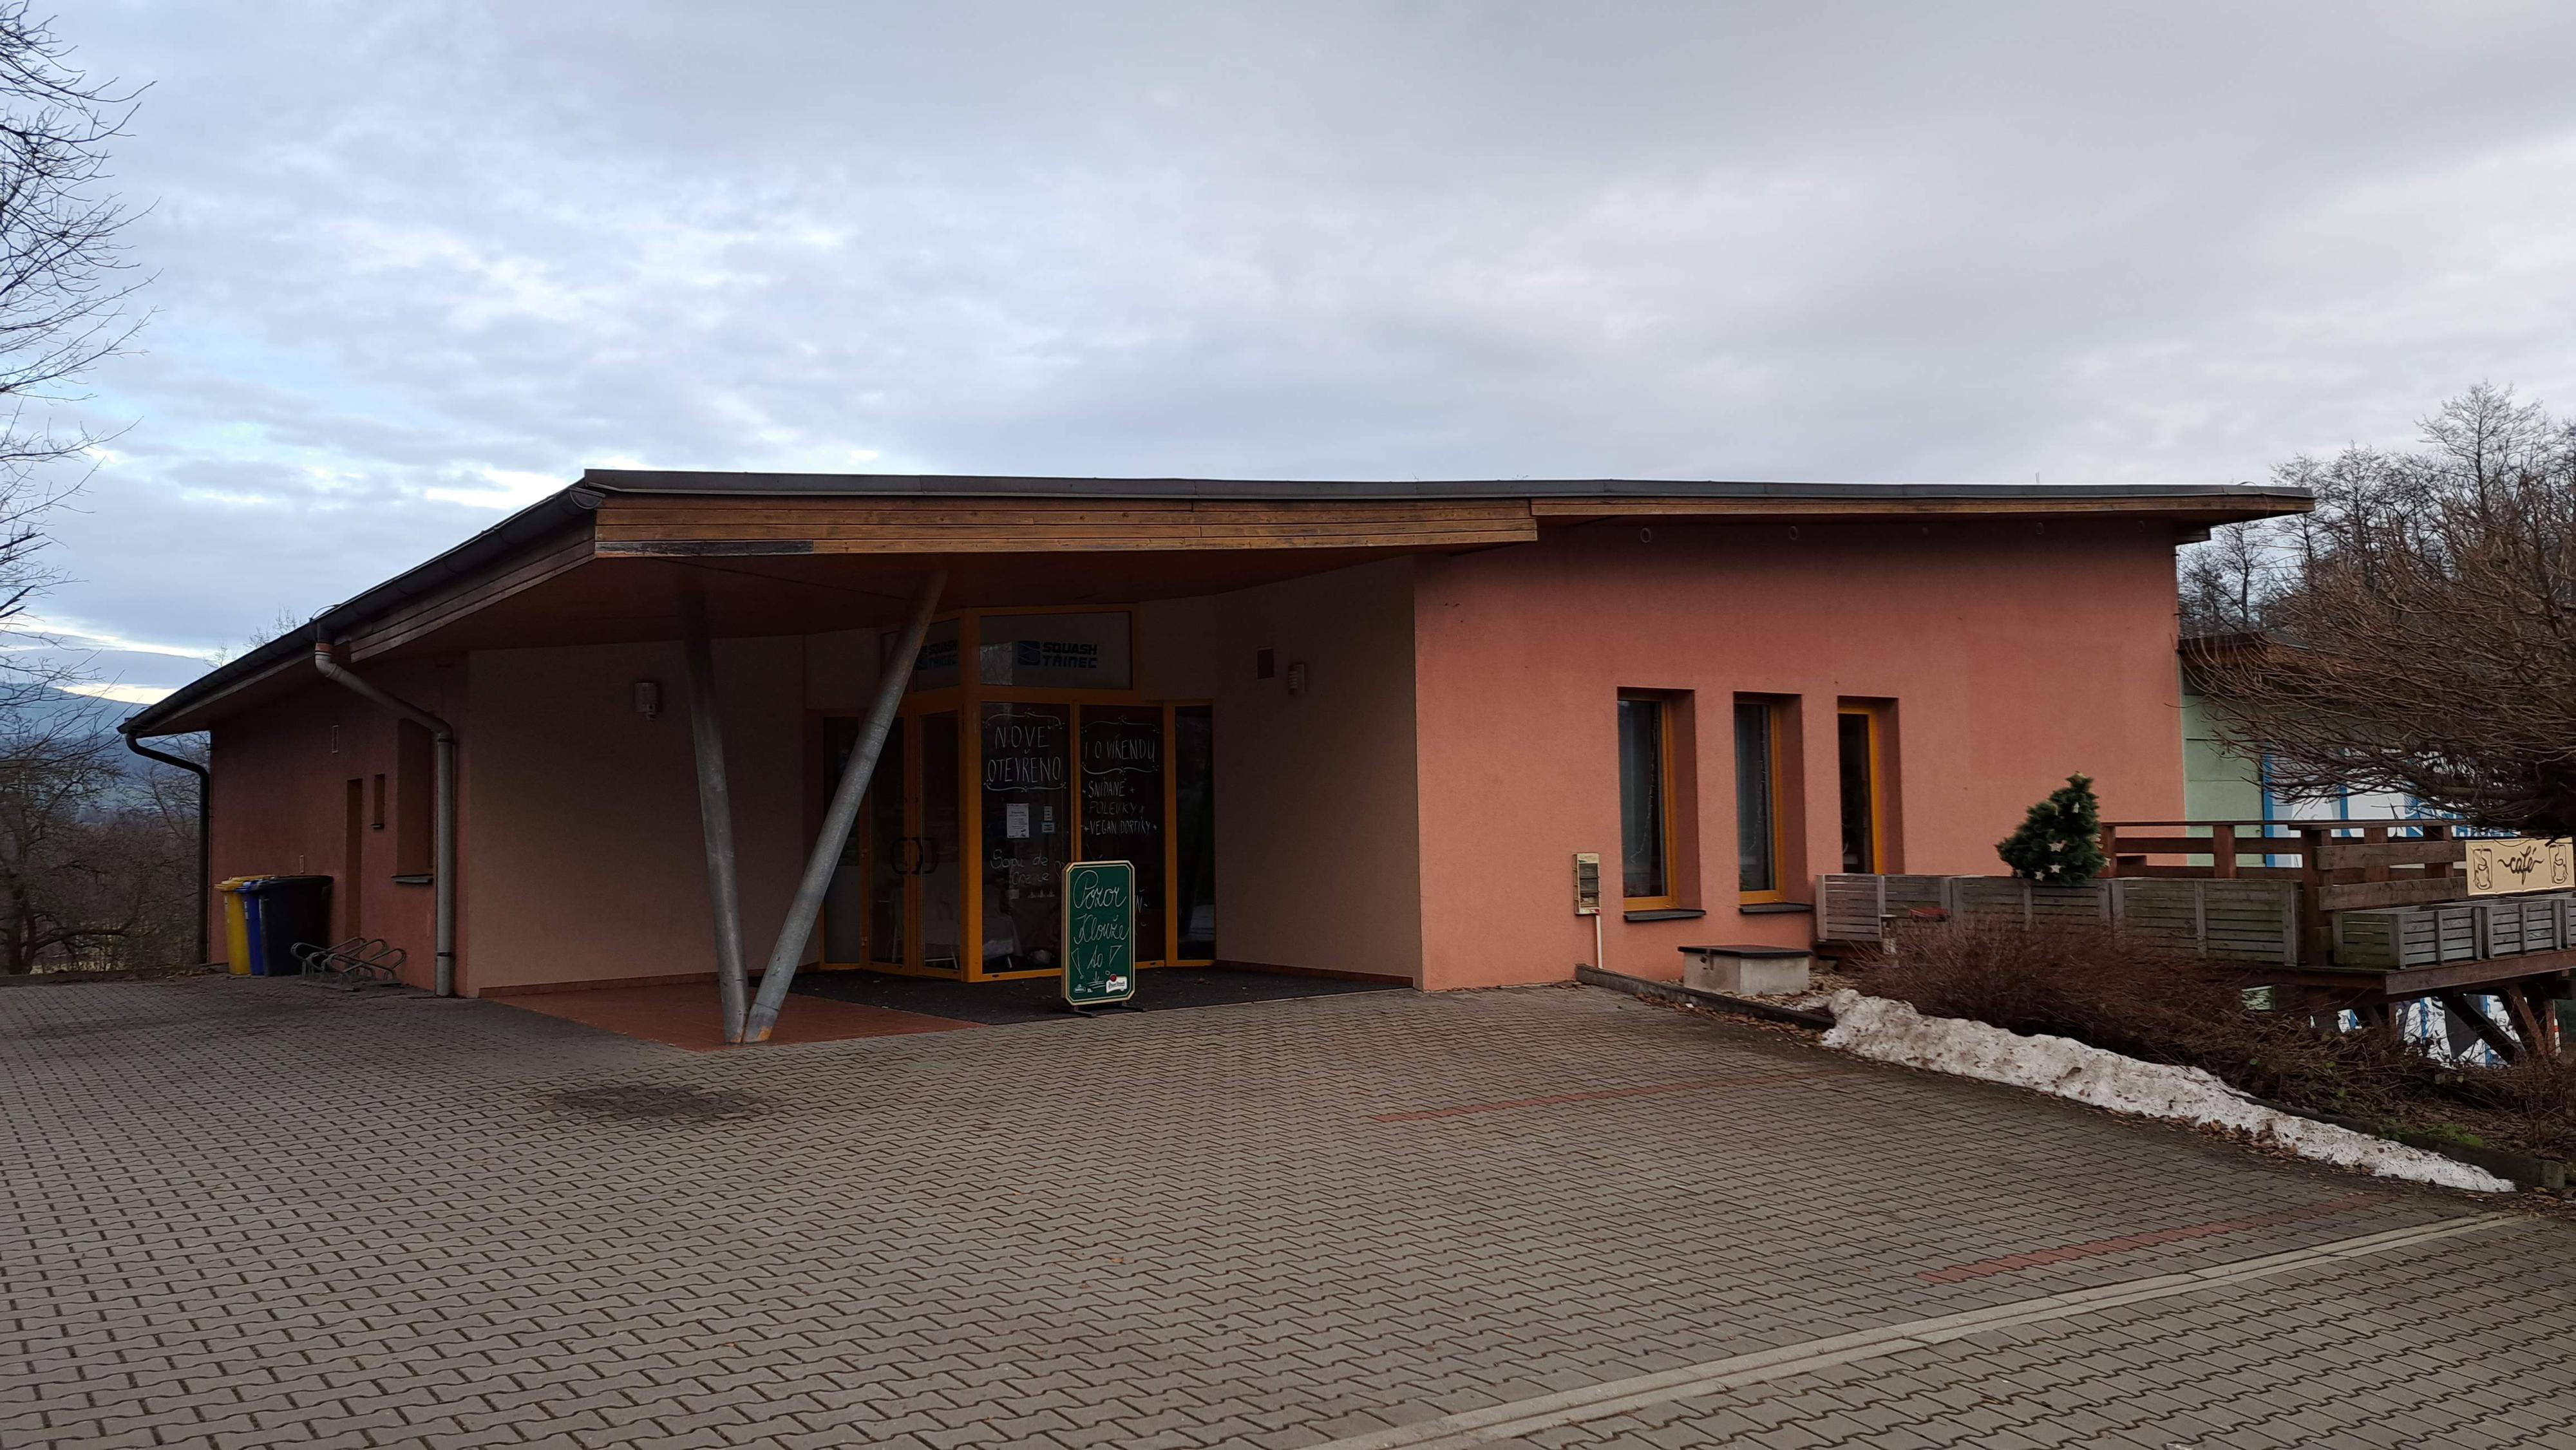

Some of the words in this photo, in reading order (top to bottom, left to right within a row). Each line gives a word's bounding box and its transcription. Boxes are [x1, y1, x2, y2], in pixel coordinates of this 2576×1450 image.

[1043, 641, 1097, 655] SQUASH
[988, 748, 1061, 783] OTEVŘENO
[1090, 819, 1117, 835] VEGAN
[2500, 845, 2543, 885] café
[1072, 869, 1127, 910] Pozor
[1074, 914, 1130, 945] Klouže
